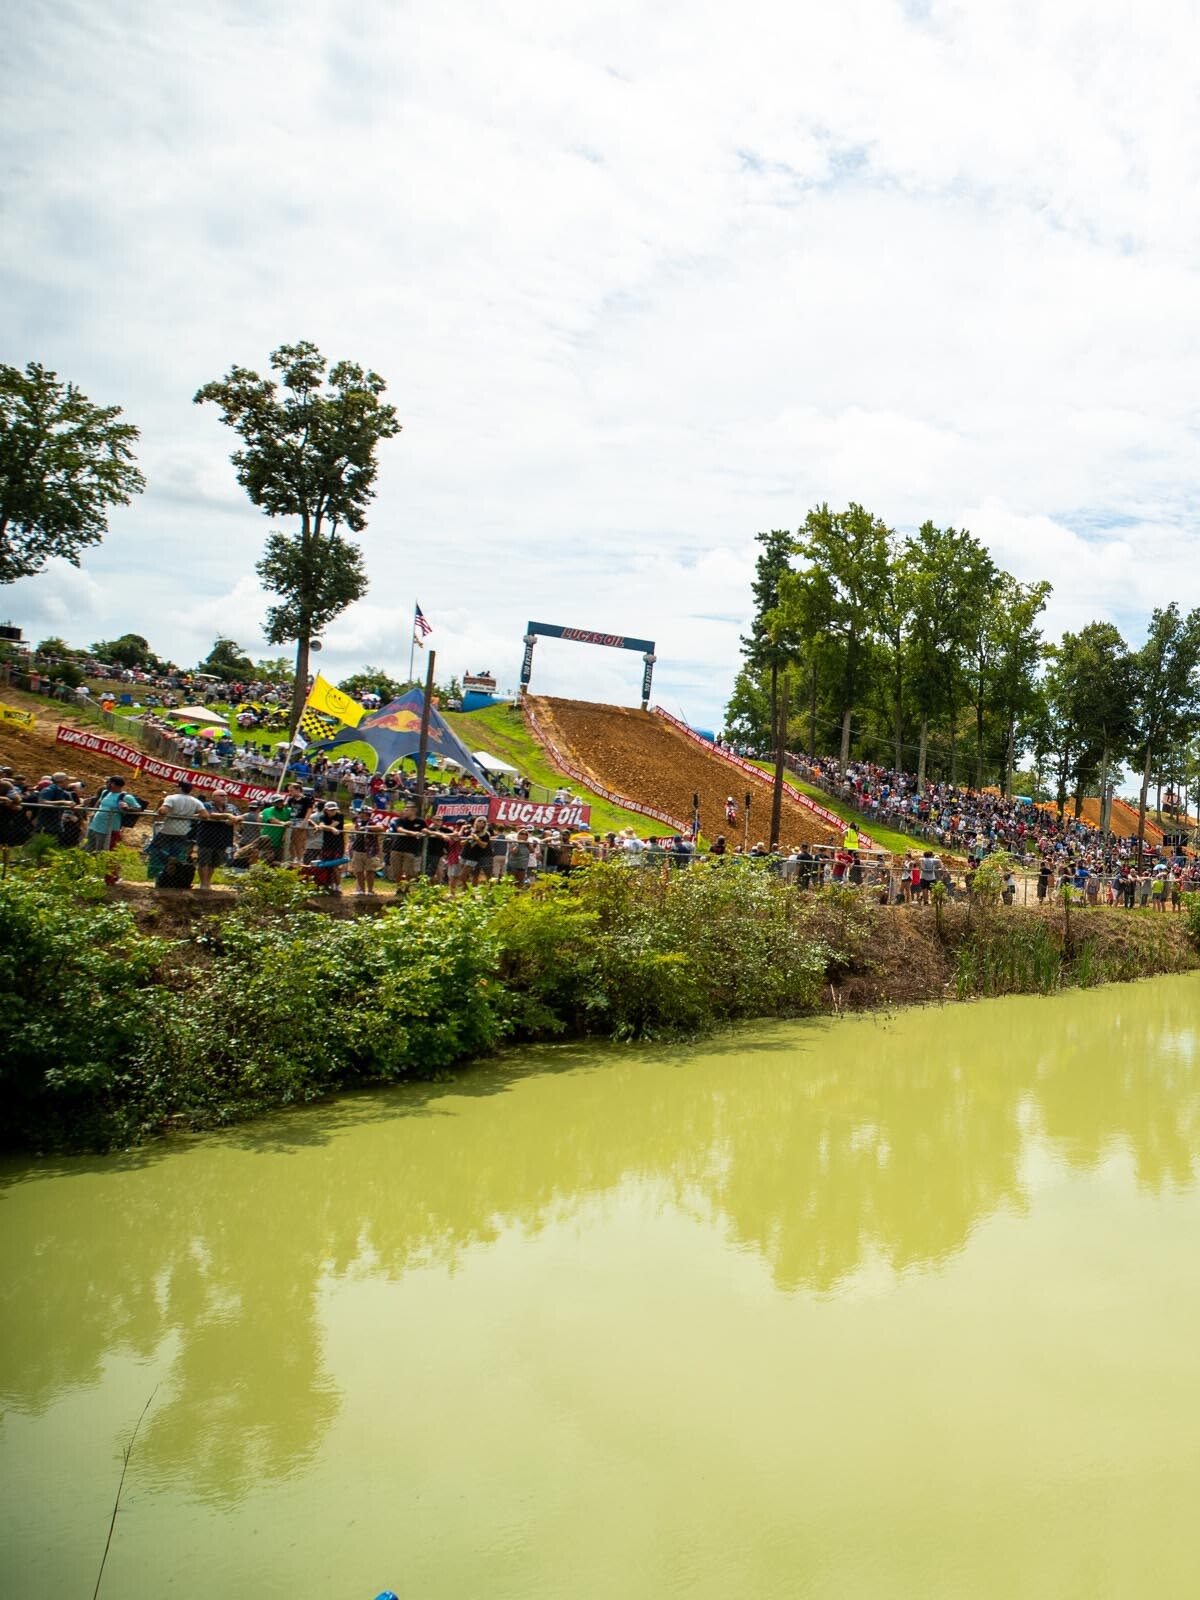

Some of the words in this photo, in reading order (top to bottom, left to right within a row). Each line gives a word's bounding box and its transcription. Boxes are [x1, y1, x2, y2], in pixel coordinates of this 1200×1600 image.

[561, 627, 603, 645] LUCAS
[603, 634, 625, 648] OIL
[58, 729, 88, 747] LUCAS
[86, 738, 100, 750] OIL
[102, 741, 128, 760] LUCAS
[127, 752, 142, 767] OIL
[144, 759, 173, 778] LUCAS
[172, 769, 189, 782] OIL
[192, 774, 225, 791] LUCAS
[224, 783, 241, 796] OIL
[496, 801, 555, 825] LUCAS
[557, 806, 584, 826] OIL
